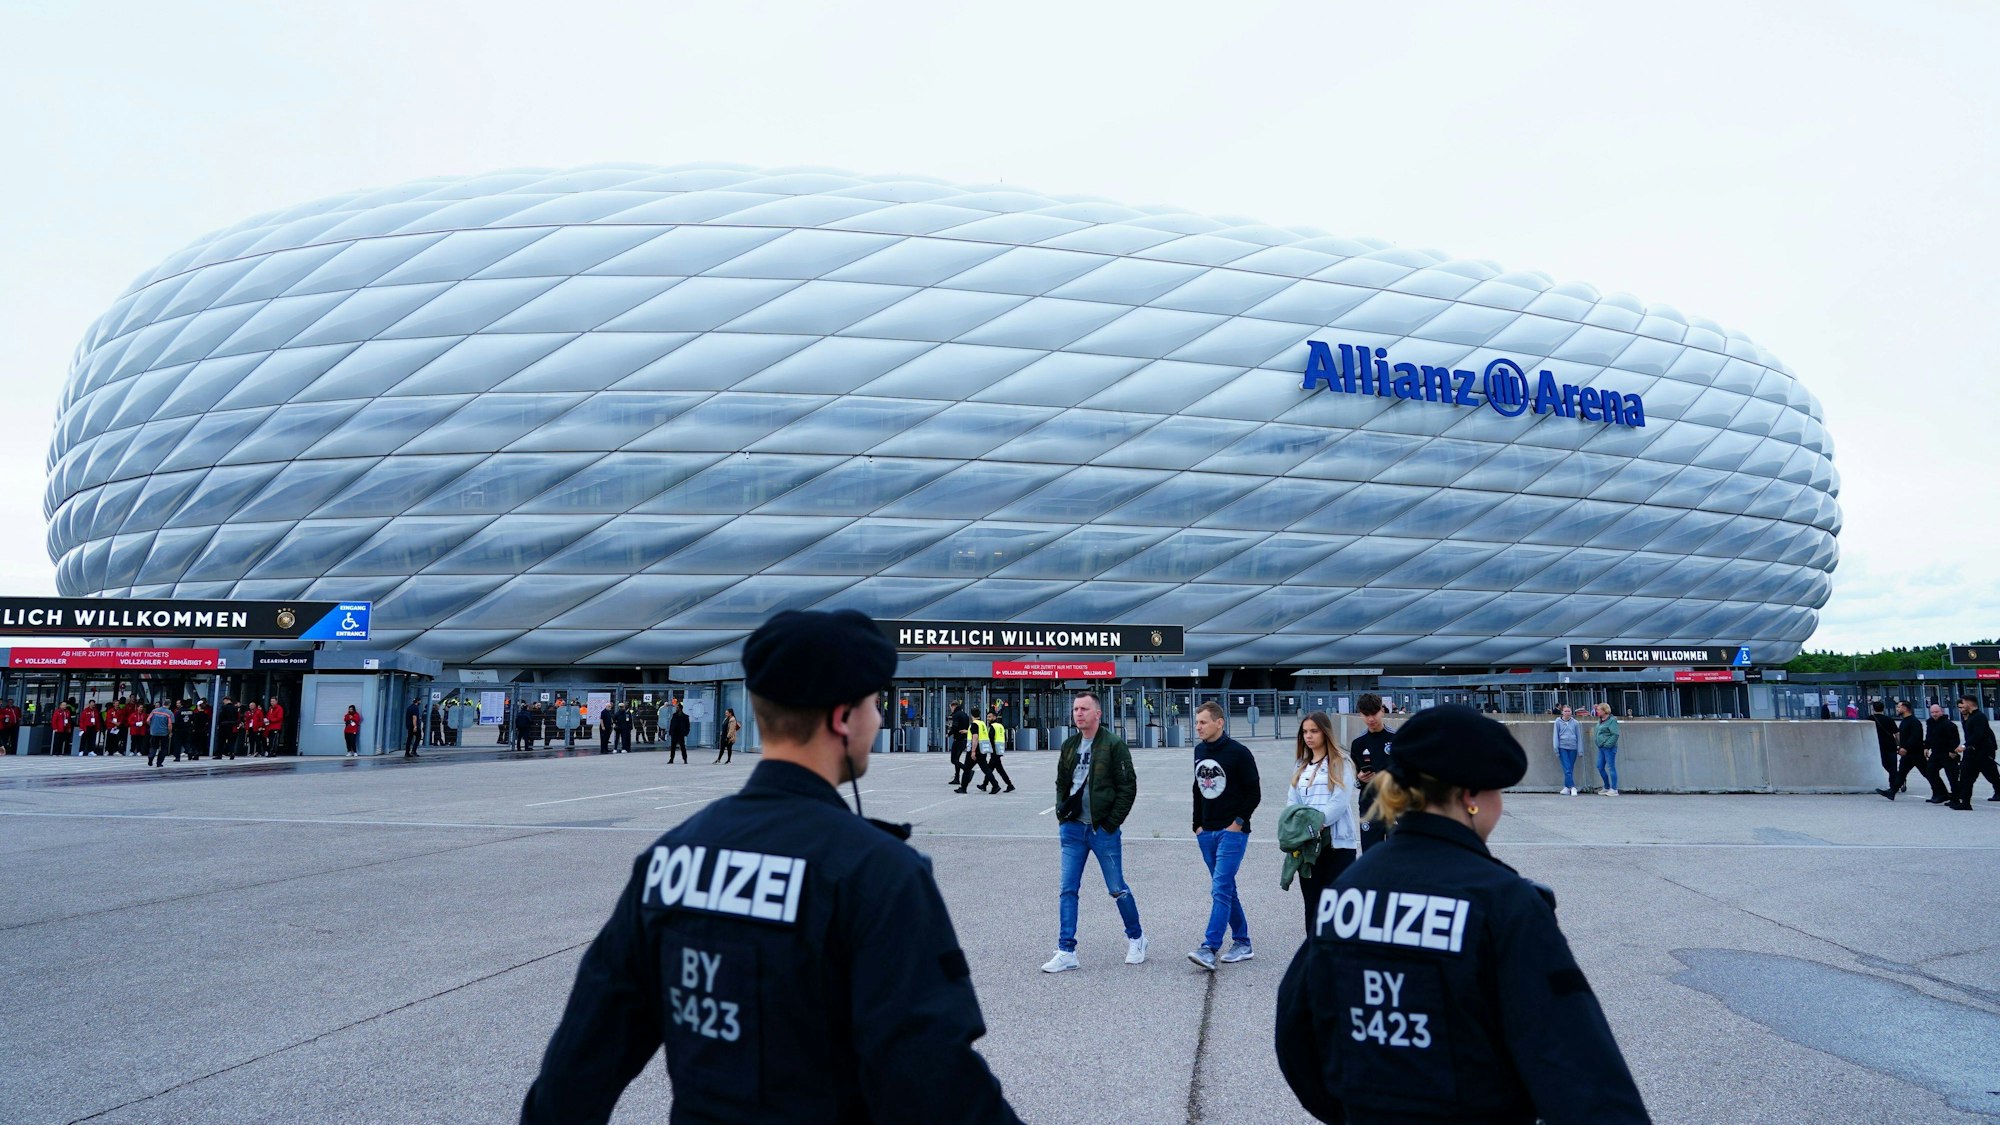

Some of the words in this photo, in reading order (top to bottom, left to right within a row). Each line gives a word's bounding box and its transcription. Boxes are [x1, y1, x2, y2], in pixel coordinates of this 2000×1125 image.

[1303, 340, 1479, 406] Allianz
[1535, 370, 1646, 428] Arena
[74, 610, 247, 627] WILLKOMMEN
[900, 629, 994, 645] HERZLICH
[1001, 630, 1121, 647] WILLKOMMEN
[61, 650, 71, 658] AB
[72, 650, 87, 658] HIER
[88, 650, 114, 658] ZUTRITT
[116, 650, 130, 658] NUR
[131, 650, 143, 658] MIT
[144, 650, 169, 658] TICKETS
[1605, 650, 1649, 661] HERZLICH
[1651, 651, 1708, 661] WILLKOMMEN
[642, 844, 806, 923] POLIZEI
[1316, 887, 1470, 952] POLIZEI
[682, 947, 722, 993] BY
[1363, 969, 1405, 1007] BY
[670, 986, 740, 1041] 5423
[1350, 1006, 1432, 1048] 5423
